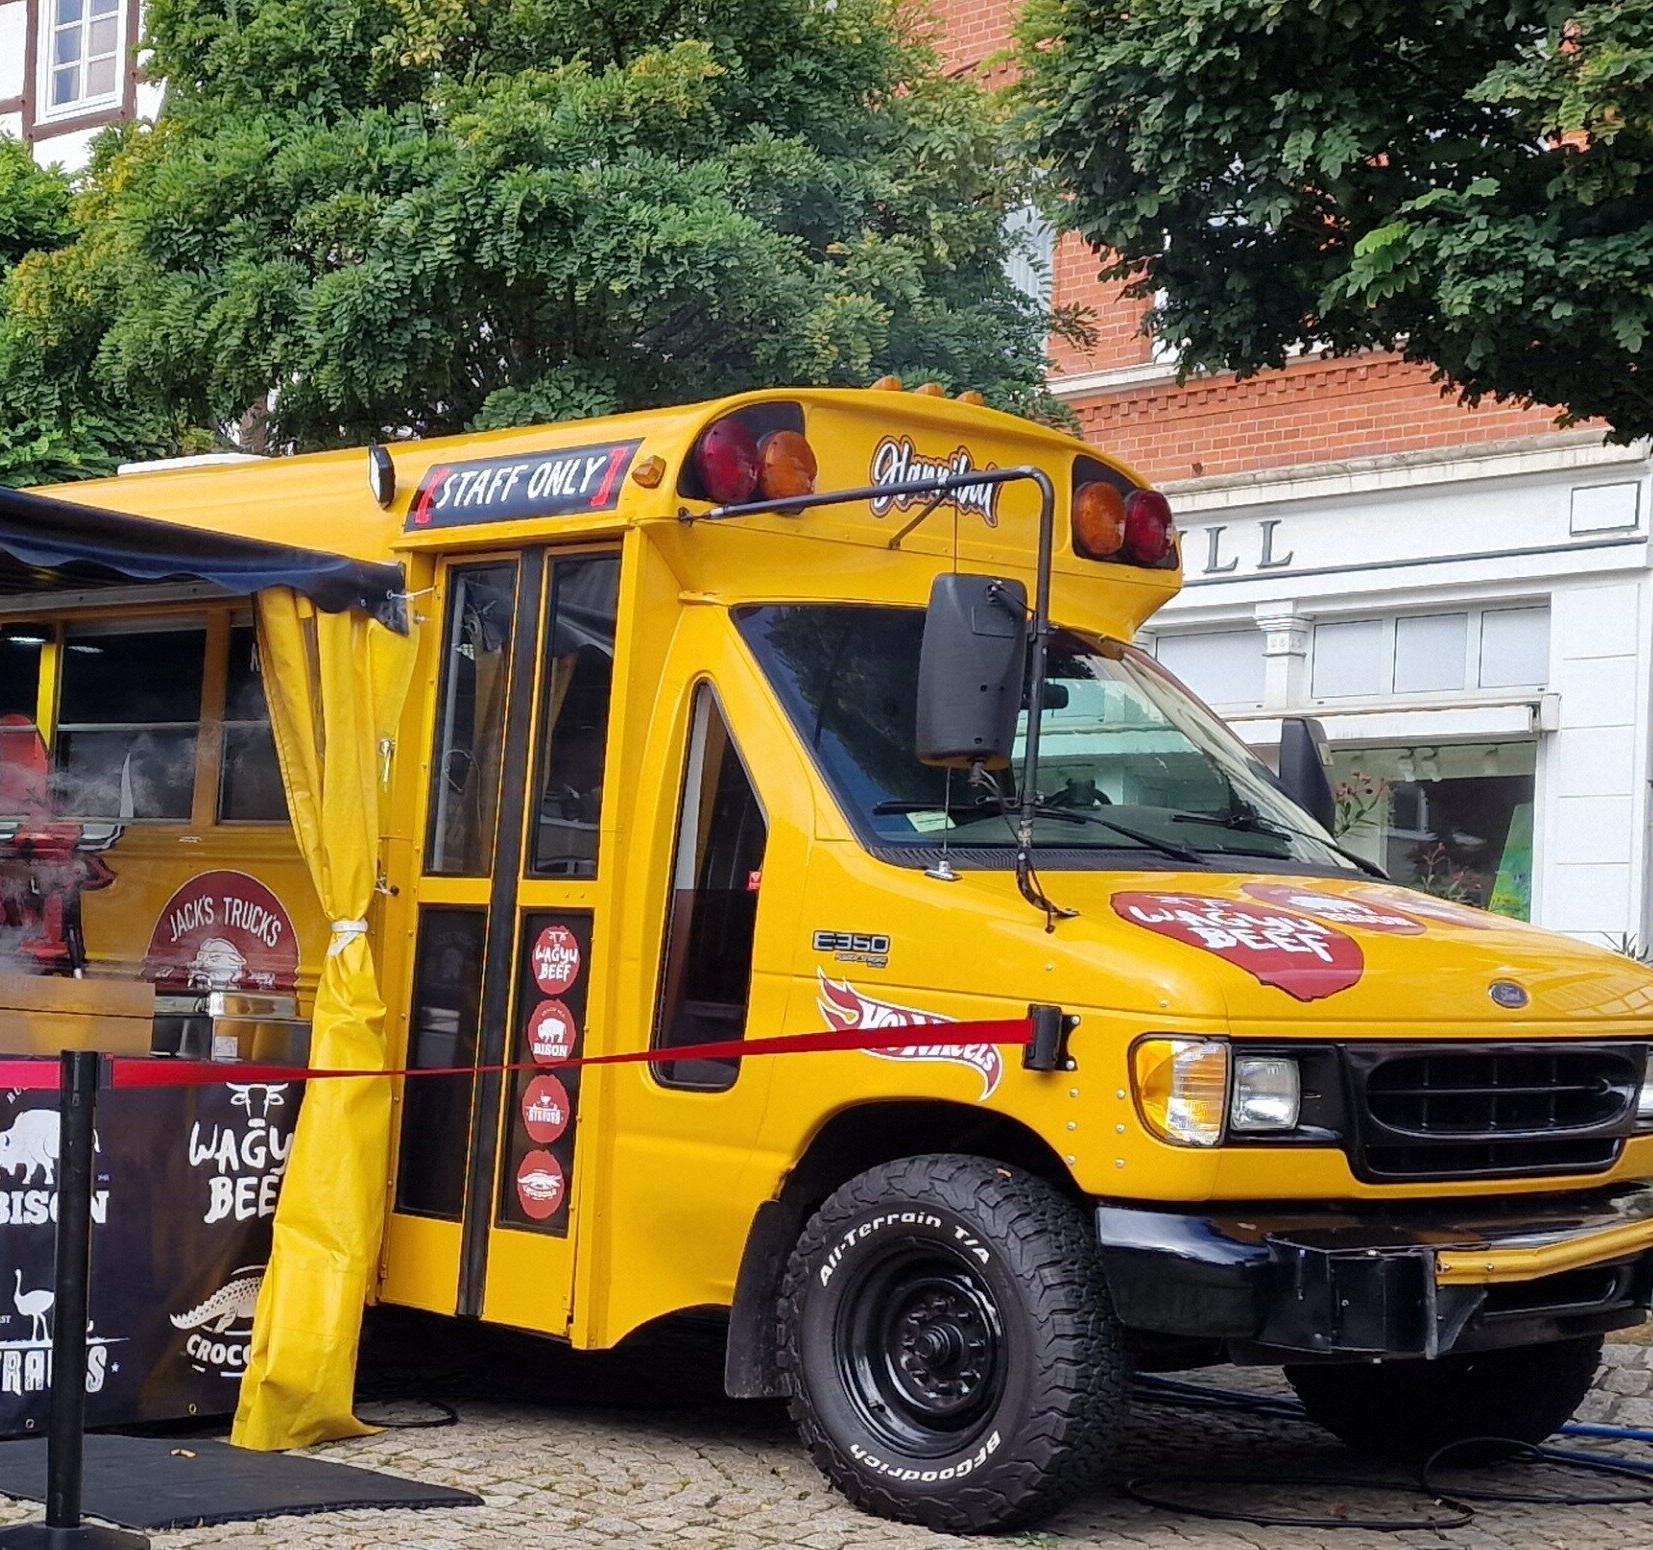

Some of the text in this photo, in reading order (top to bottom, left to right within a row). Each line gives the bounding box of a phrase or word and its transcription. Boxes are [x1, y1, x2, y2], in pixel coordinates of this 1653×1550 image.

[434, 455, 608, 510] STAFF ONLY
[169, 894, 283, 948] JACK'S TRUCK'S
[814, 930, 890, 953] E350
[1128, 904, 1334, 936] WAGYU
[535, 943, 578, 965] WAGYU
[1188, 925, 1335, 964] BEEF
[537, 962, 572, 983] BEEF
[532, 1042, 569, 1058] BISON
[188, 1121, 294, 1174] WAGY
[203, 1174, 280, 1224] BEE
[819, 1210, 991, 1288] All-Terrain T/A
[849, 1429, 1002, 1483] BFGoodrich
